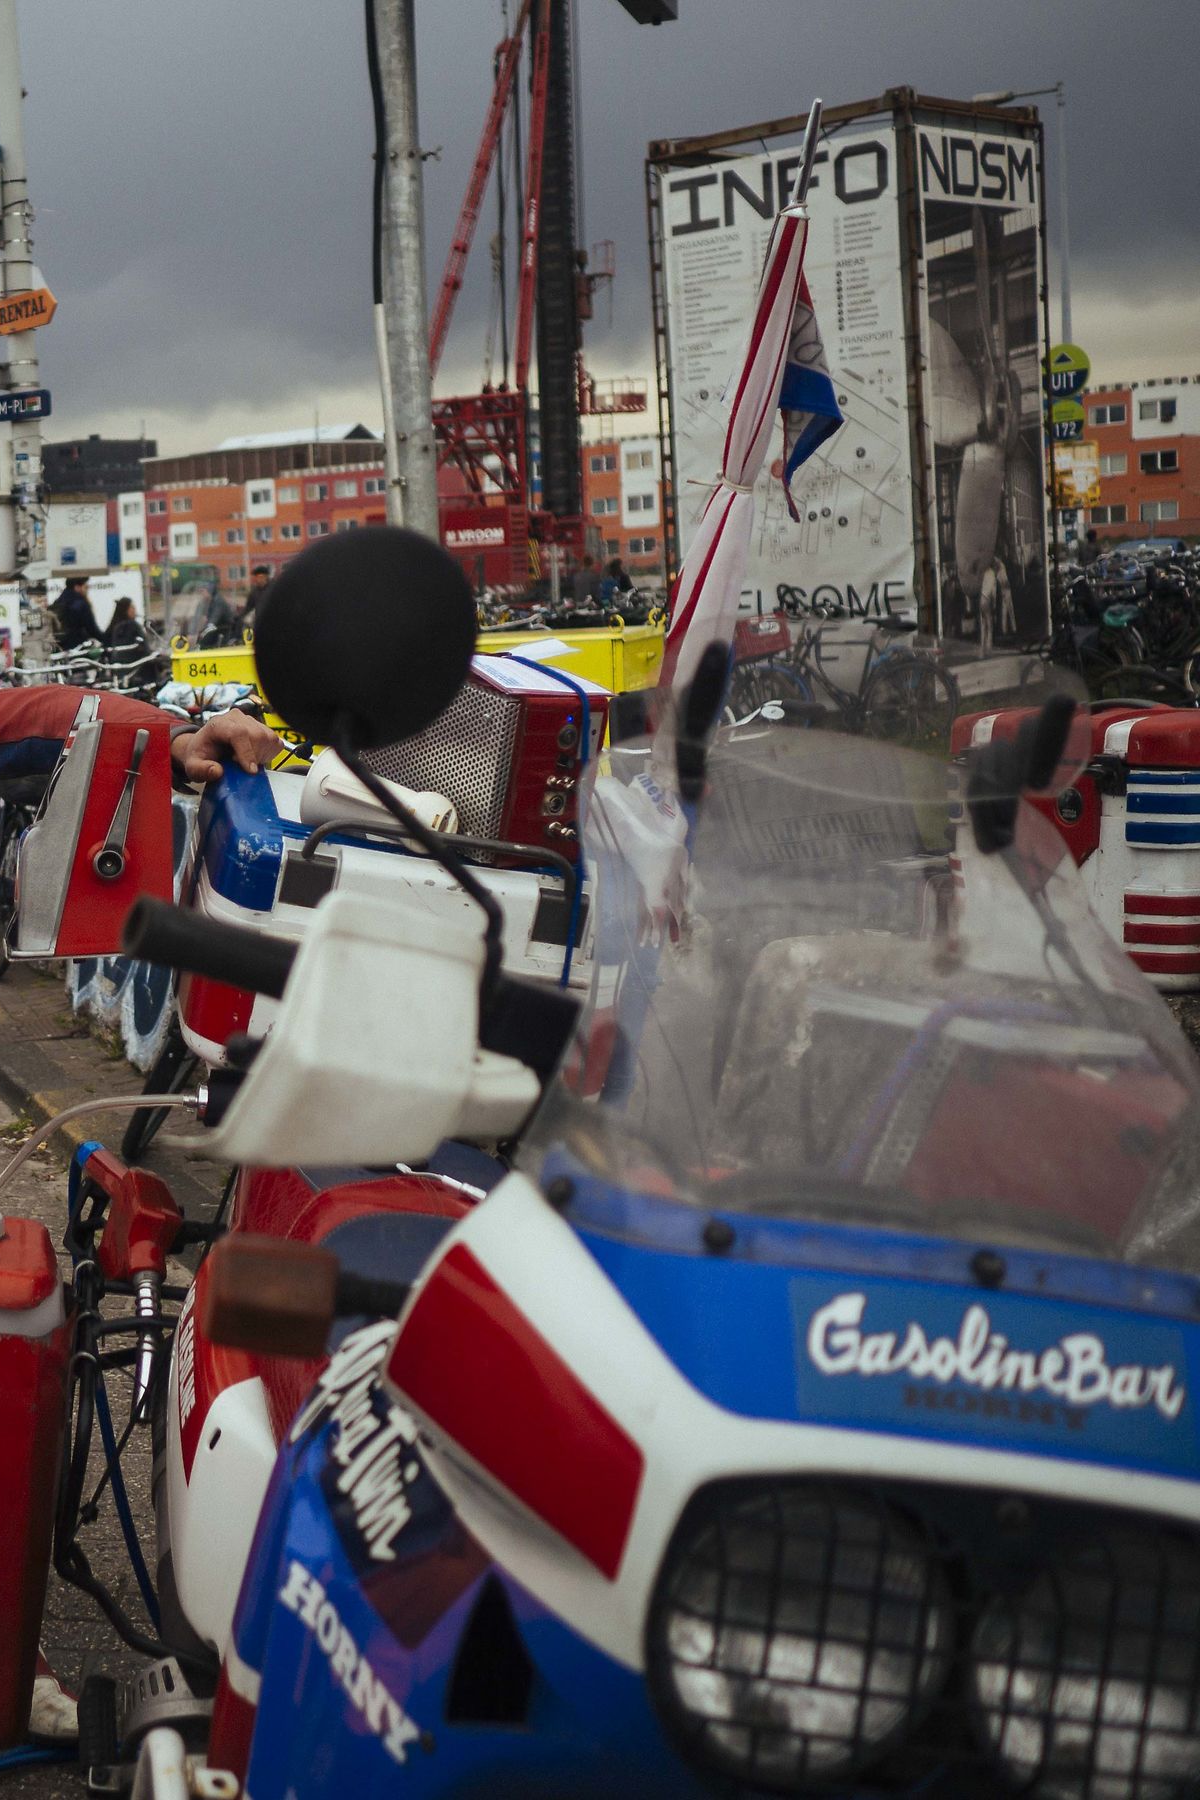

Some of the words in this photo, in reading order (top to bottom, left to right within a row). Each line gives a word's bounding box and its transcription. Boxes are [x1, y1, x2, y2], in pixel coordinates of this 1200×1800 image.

[669, 140, 889, 237] INFO
[919, 132, 1035, 203] NDSM
[0, 295, 46, 326] RENTAL
[1051, 370, 1077, 391] UIT
[1055, 420, 1077, 438] 172
[278, 1559, 421, 1764] HORNY
